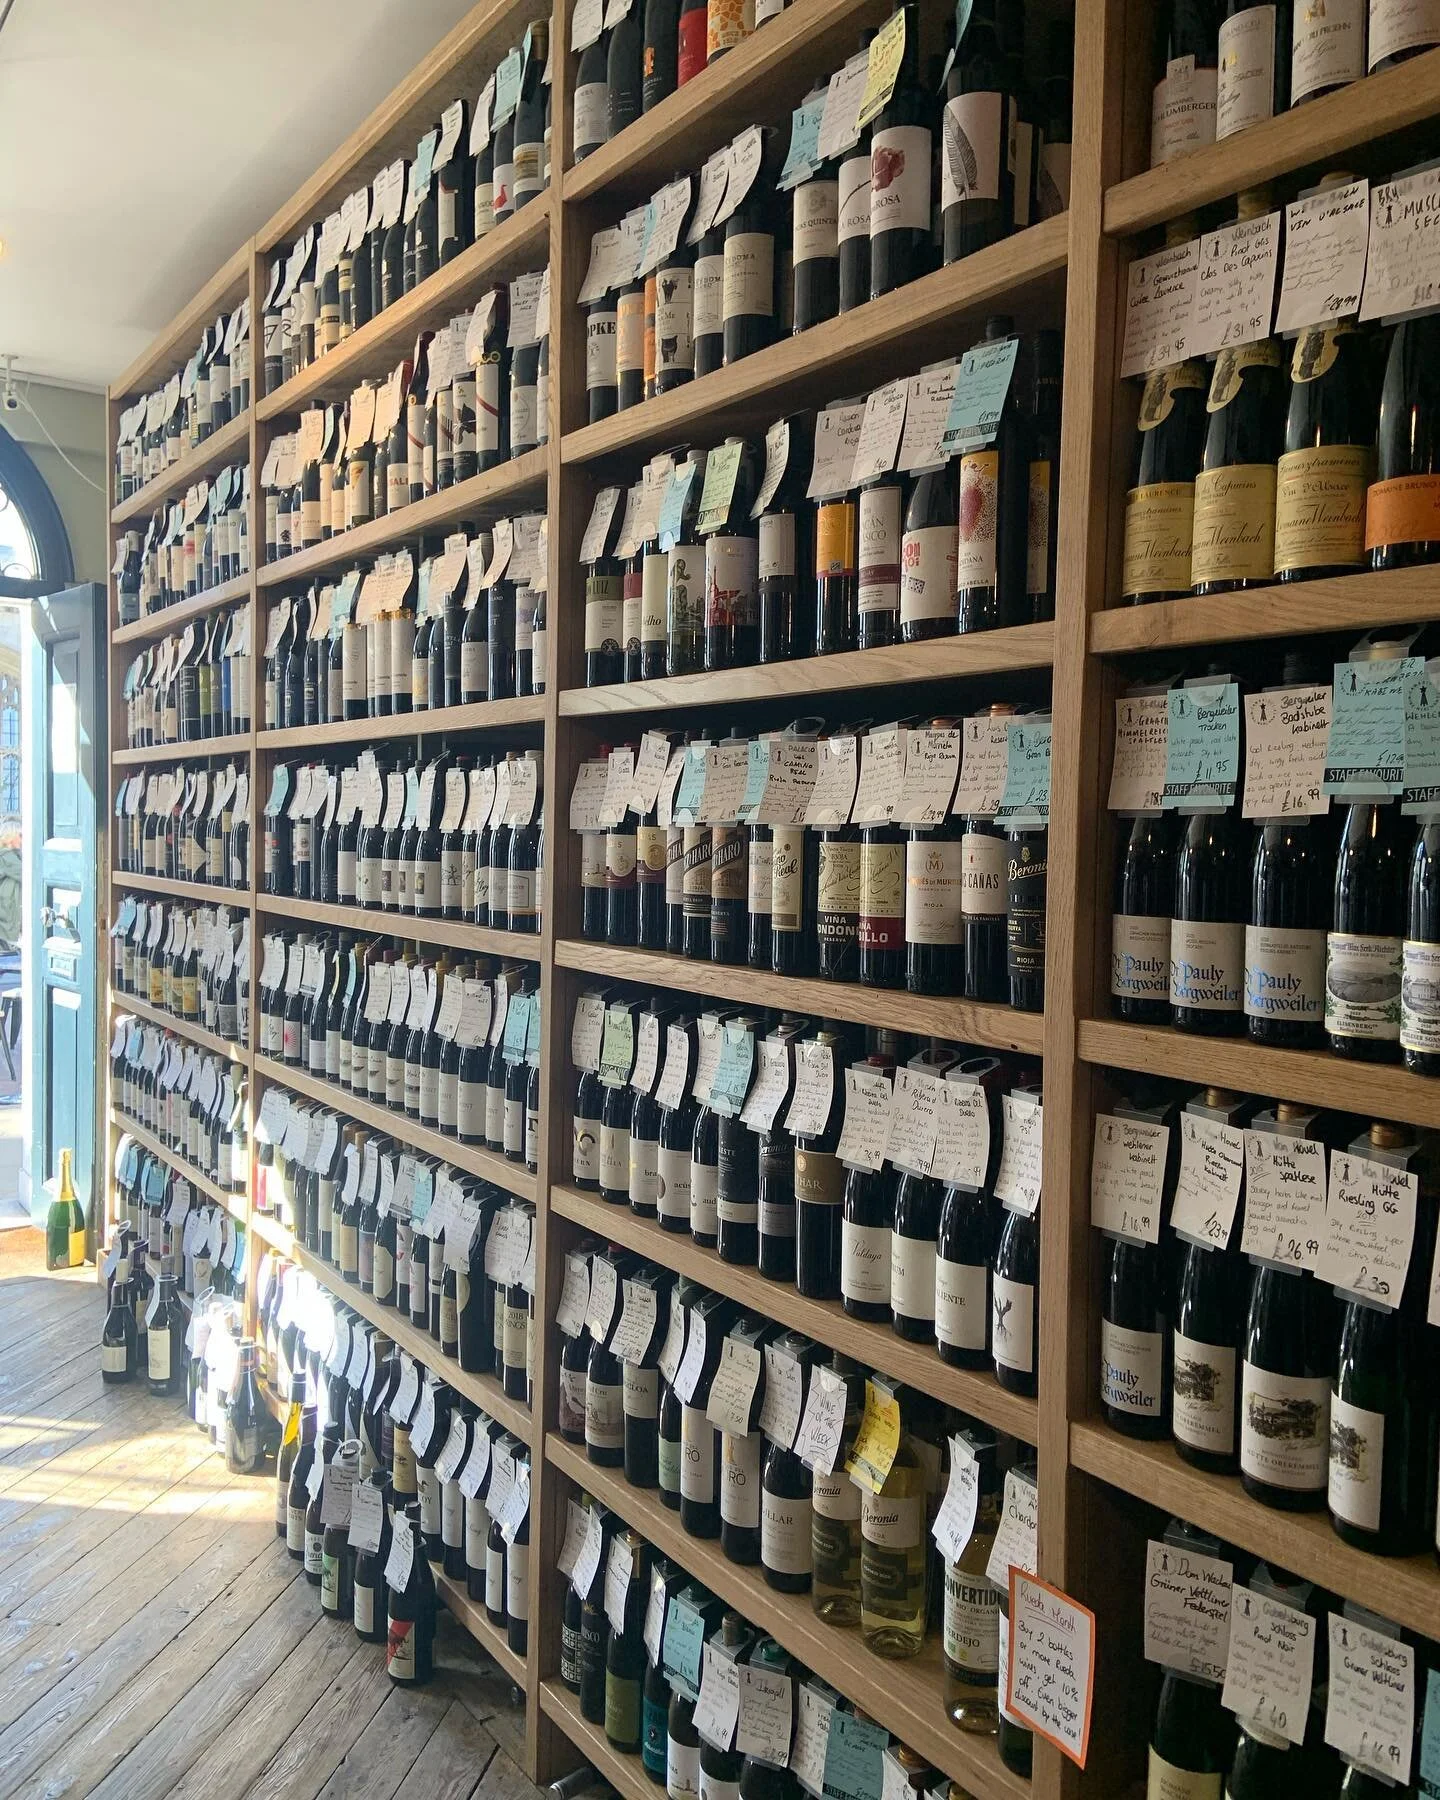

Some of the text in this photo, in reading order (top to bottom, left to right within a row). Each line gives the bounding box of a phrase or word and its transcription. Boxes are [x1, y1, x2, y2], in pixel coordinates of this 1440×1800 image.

[1152, 102, 1217, 124] HLUMBERGER
[1405, 482, 1436, 490] BRUNO
[1205, 522, 1266, 547] Weinbach
[1280, 692, 1327, 710] Bergweiler
[1117, 728, 1168, 738] HIMMELREIC
[1166, 783, 1188, 796] STAFF
[968, 872, 999, 889] CAÑAS
[824, 914, 847, 924] VIÑA
[817, 924, 860, 936] ONDON
[1016, 956, 1036, 964] RIOJA
[1120, 952, 1164, 978] Pauly
[1179, 960, 1225, 986] Pauly
[1252, 966, 1301, 996] Pauly
[1382, 1201, 1400, 1215] GG
[862, 1503, 899, 1524] Beronia
[1020, 1582, 1046, 1614] Rueda
[1037, 1632, 1045, 1645] 2
[1048, 1637, 1074, 1661] bottles
[1032, 1650, 1051, 1666] more
[1055, 1660, 1077, 1681] Rueda
[1042, 1673, 1057, 1687] get
[1041, 1705, 1050, 1724] by
[1058, 1696, 1078, 1721] bigger
